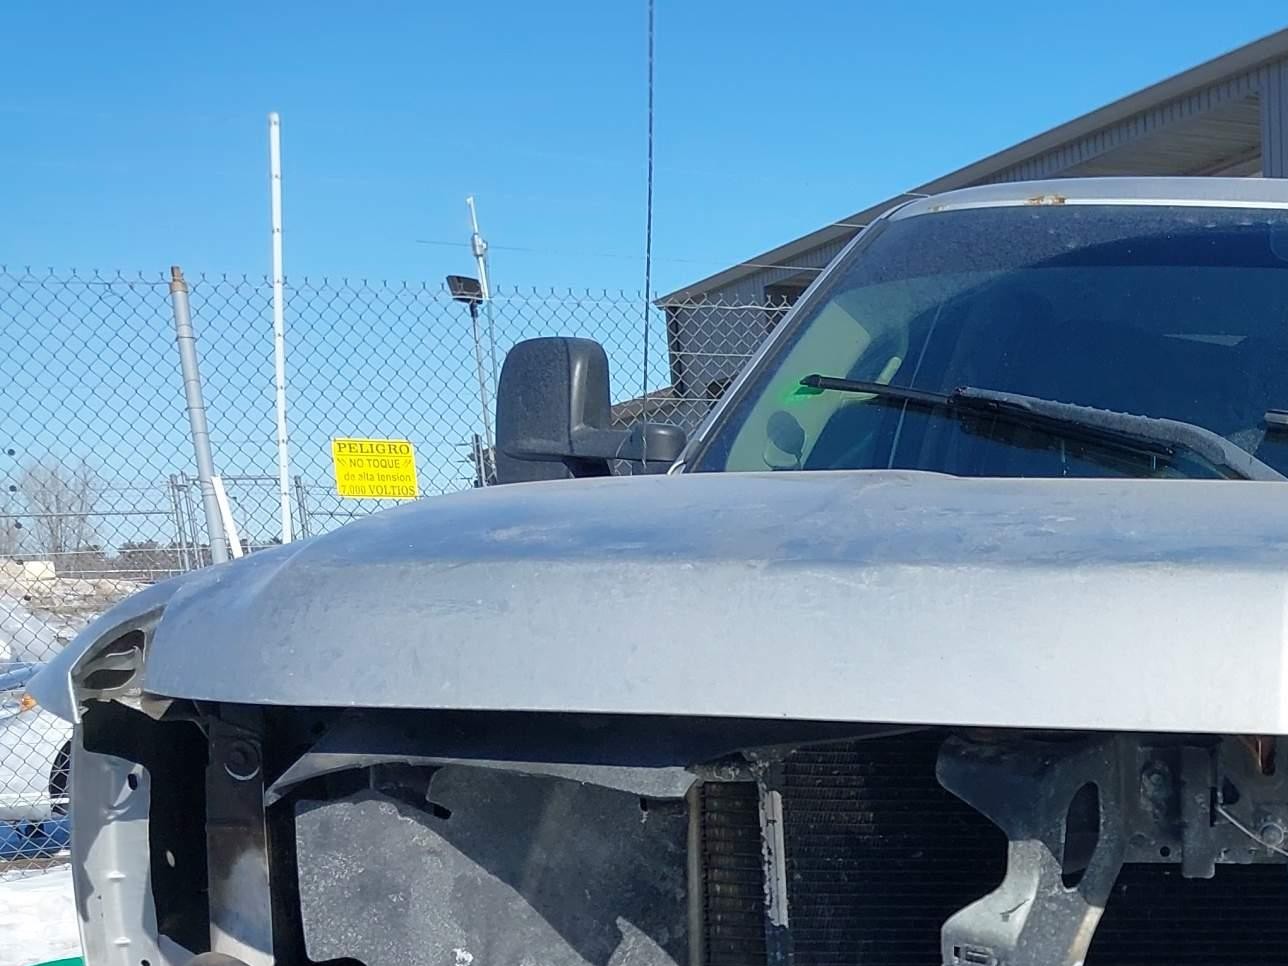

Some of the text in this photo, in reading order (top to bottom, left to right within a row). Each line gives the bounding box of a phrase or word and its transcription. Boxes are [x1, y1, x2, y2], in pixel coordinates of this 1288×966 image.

[336, 442, 410, 455] PELIGRO
[349, 458, 401, 469] NO TOQUE
[344, 472, 355, 481] de
[358, 471, 375, 481] alta
[368, 485, 416, 496] VOLTIOS
